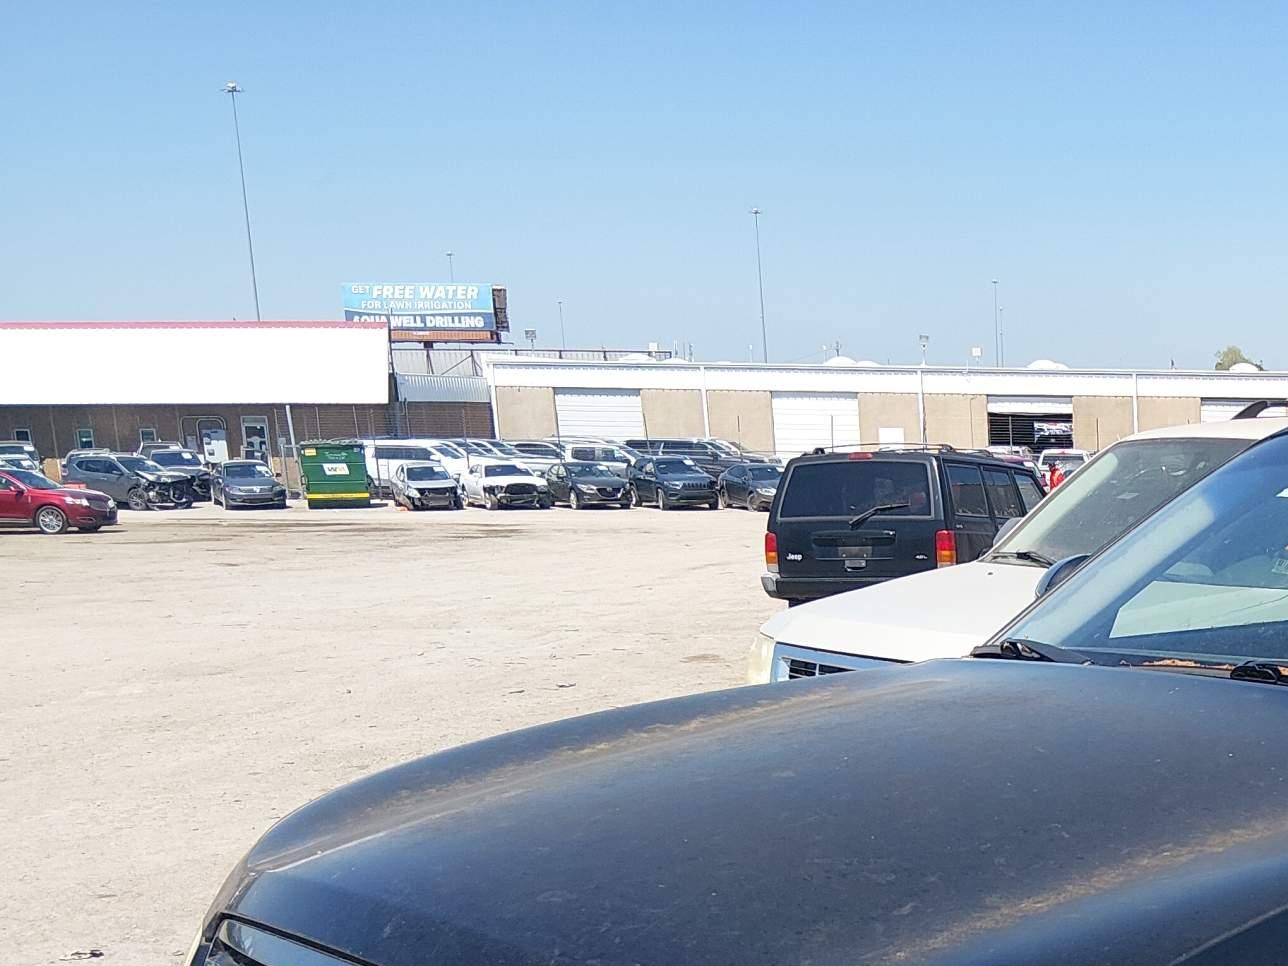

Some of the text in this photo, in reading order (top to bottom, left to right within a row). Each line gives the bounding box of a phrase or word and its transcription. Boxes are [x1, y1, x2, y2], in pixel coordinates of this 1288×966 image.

[351, 285, 479, 299] GET FREE WATER
[361, 301, 472, 310] FOR LAWN IRRIGATION
[389, 315, 425, 328] WELL
[426, 315, 485, 328] DRILLING
[786, 552, 803, 562] Jeep
